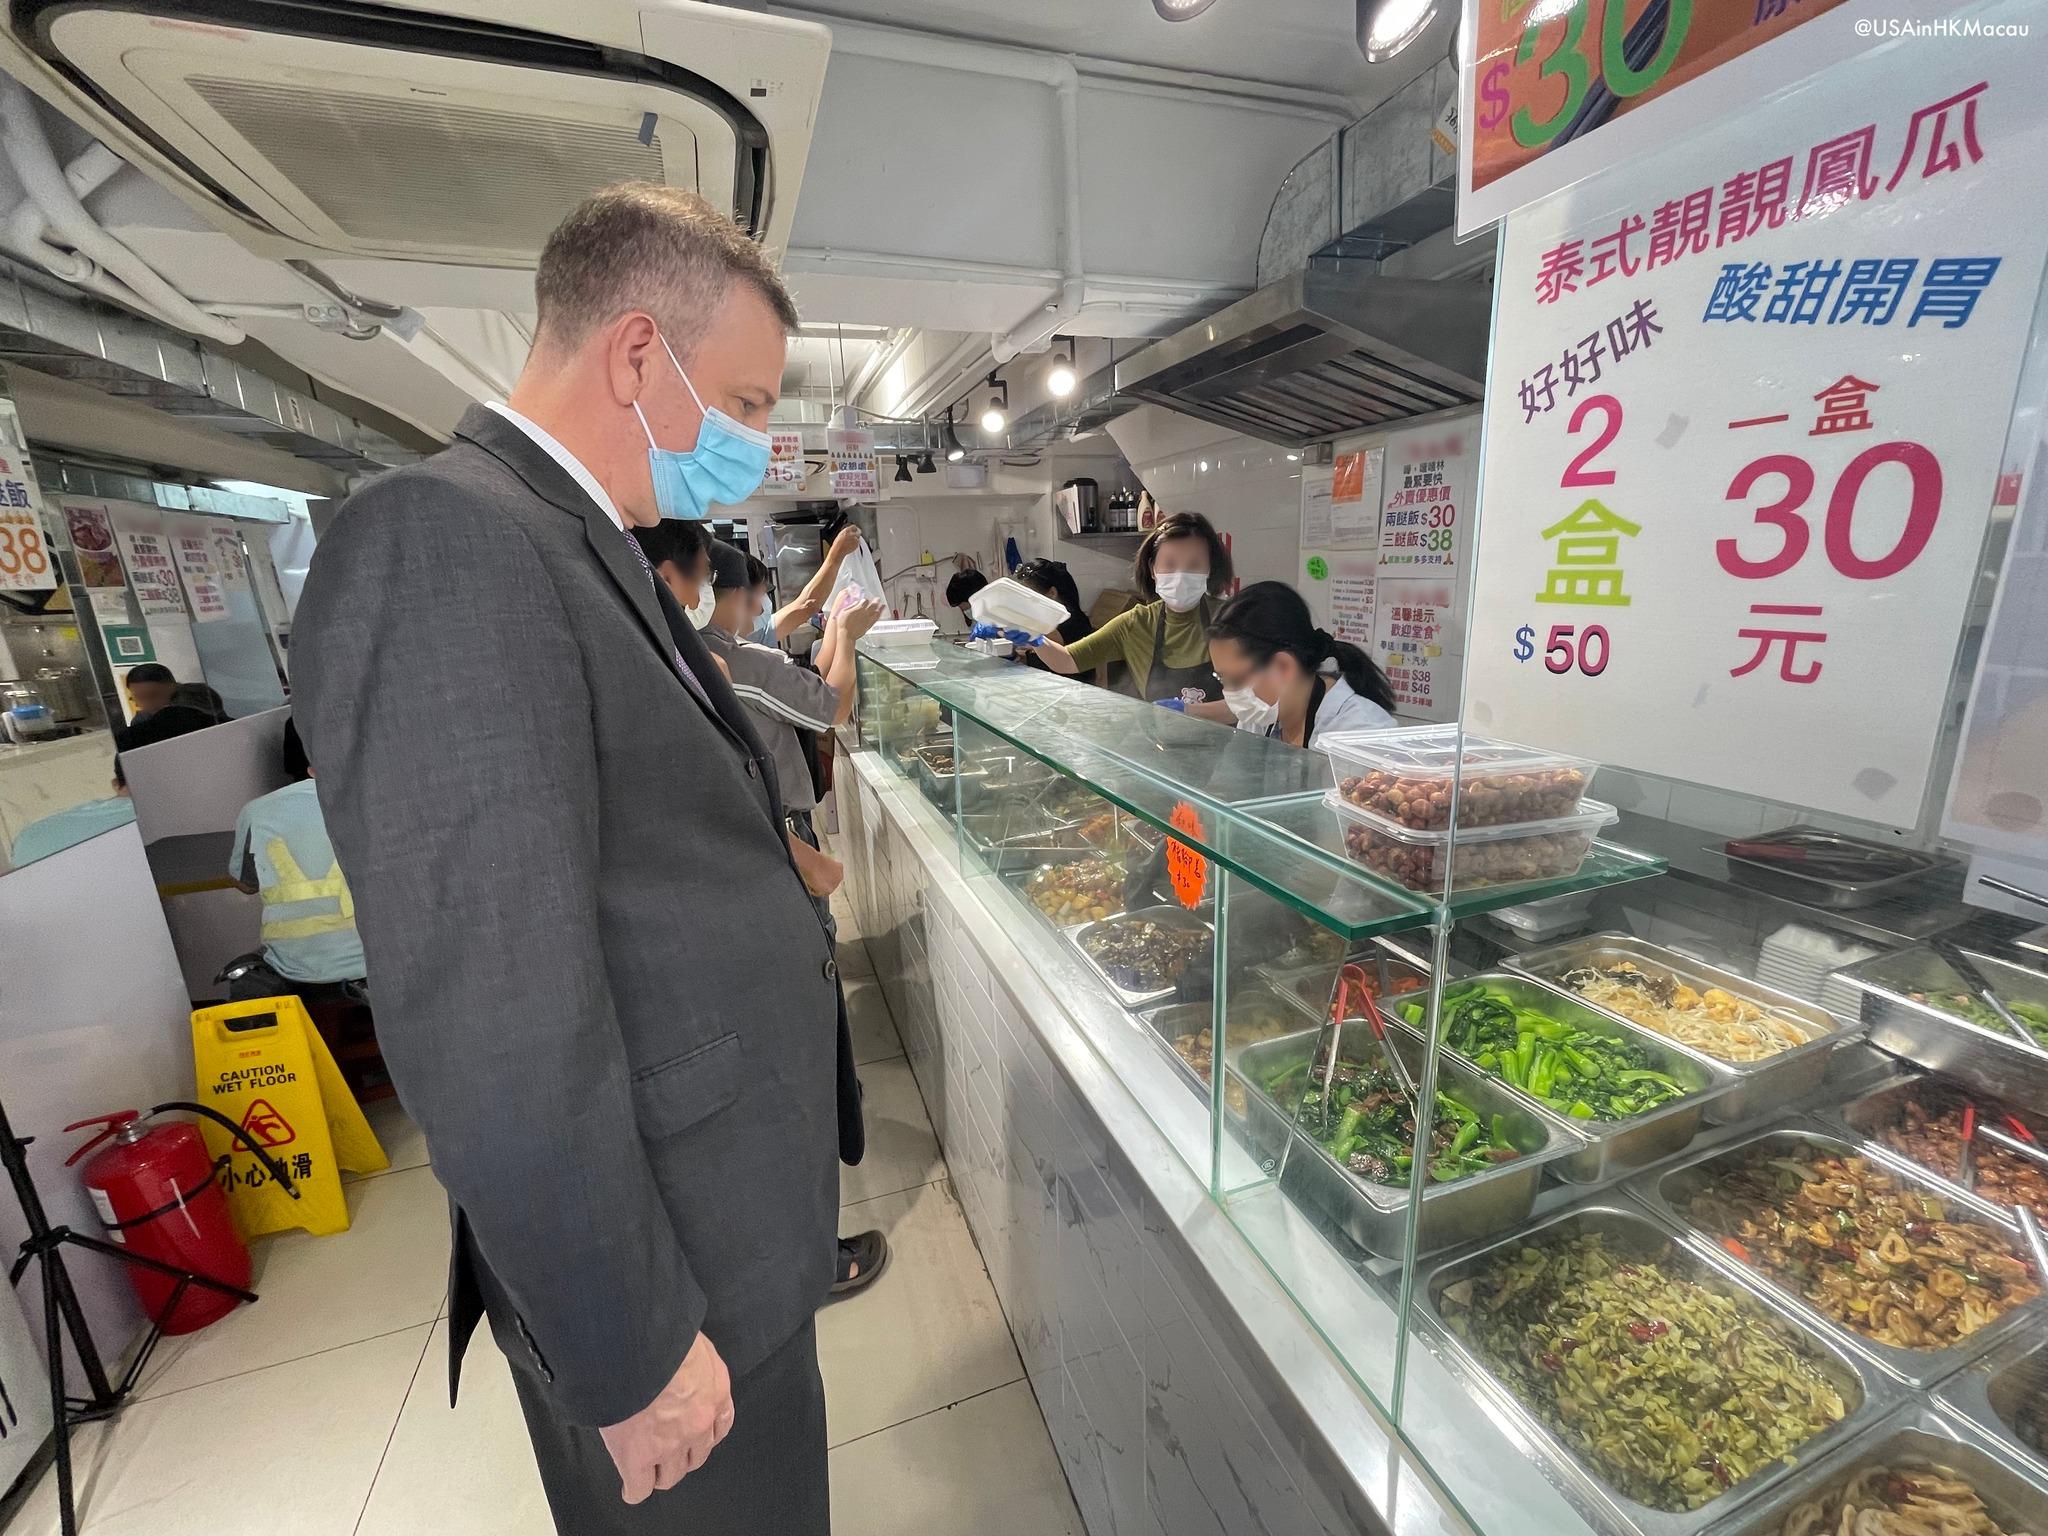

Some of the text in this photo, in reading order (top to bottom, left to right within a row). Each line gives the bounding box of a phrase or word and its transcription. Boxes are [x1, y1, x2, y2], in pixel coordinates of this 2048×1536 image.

[1702, 256, 2003, 330] 酸甜開胃
[1516, 297, 1665, 424] 好好味
[1560, 393, 1624, 489] 2
[1727, 373, 1882, 437] 一盒
[1715, 440, 1944, 581] 30
[1534, 497, 1643, 607] 盒
[1390, 623, 1434, 640] 歡迎堂食
[1728, 603, 1828, 685] 元
[212, 1072, 297, 1095] WET FLOOR
[220, 1063, 286, 1083] CAUTION
